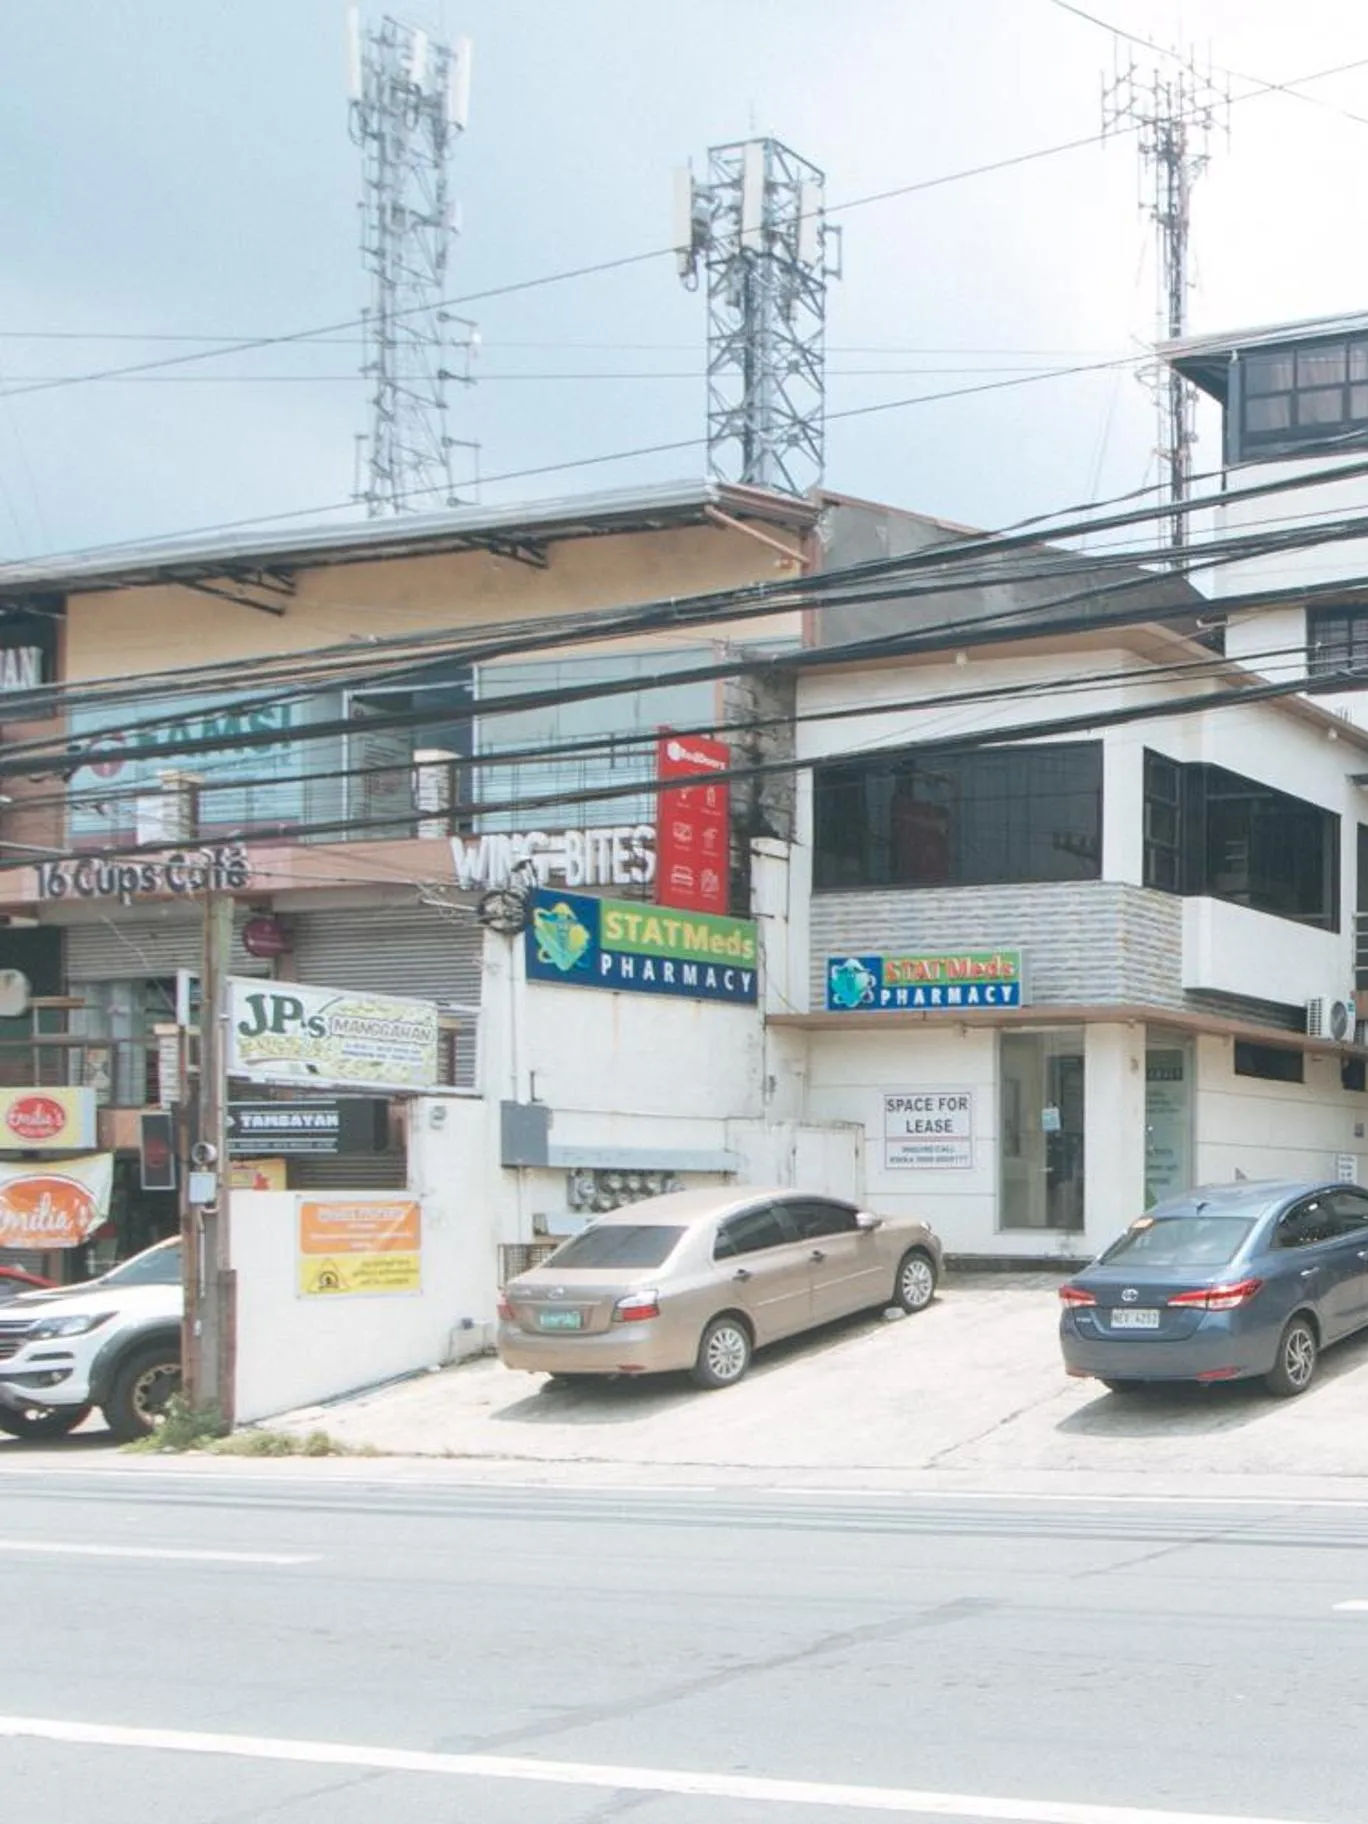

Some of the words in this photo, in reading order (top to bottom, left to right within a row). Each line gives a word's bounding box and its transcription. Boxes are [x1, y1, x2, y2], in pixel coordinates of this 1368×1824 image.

[564, 825, 657, 887] BITES
[36, 861, 67, 899] 16
[74, 858, 157, 907] Cups
[605, 911, 754, 959] STATMeds
[601, 953, 751, 993] PHARMACY
[885, 956, 1015, 983] STATMeds
[881, 985, 1012, 1006] PHARMACY
[886, 1097, 933, 1112] SPACE
[938, 1096, 968, 1111] FOR
[905, 1118, 953, 1133] LEASE
